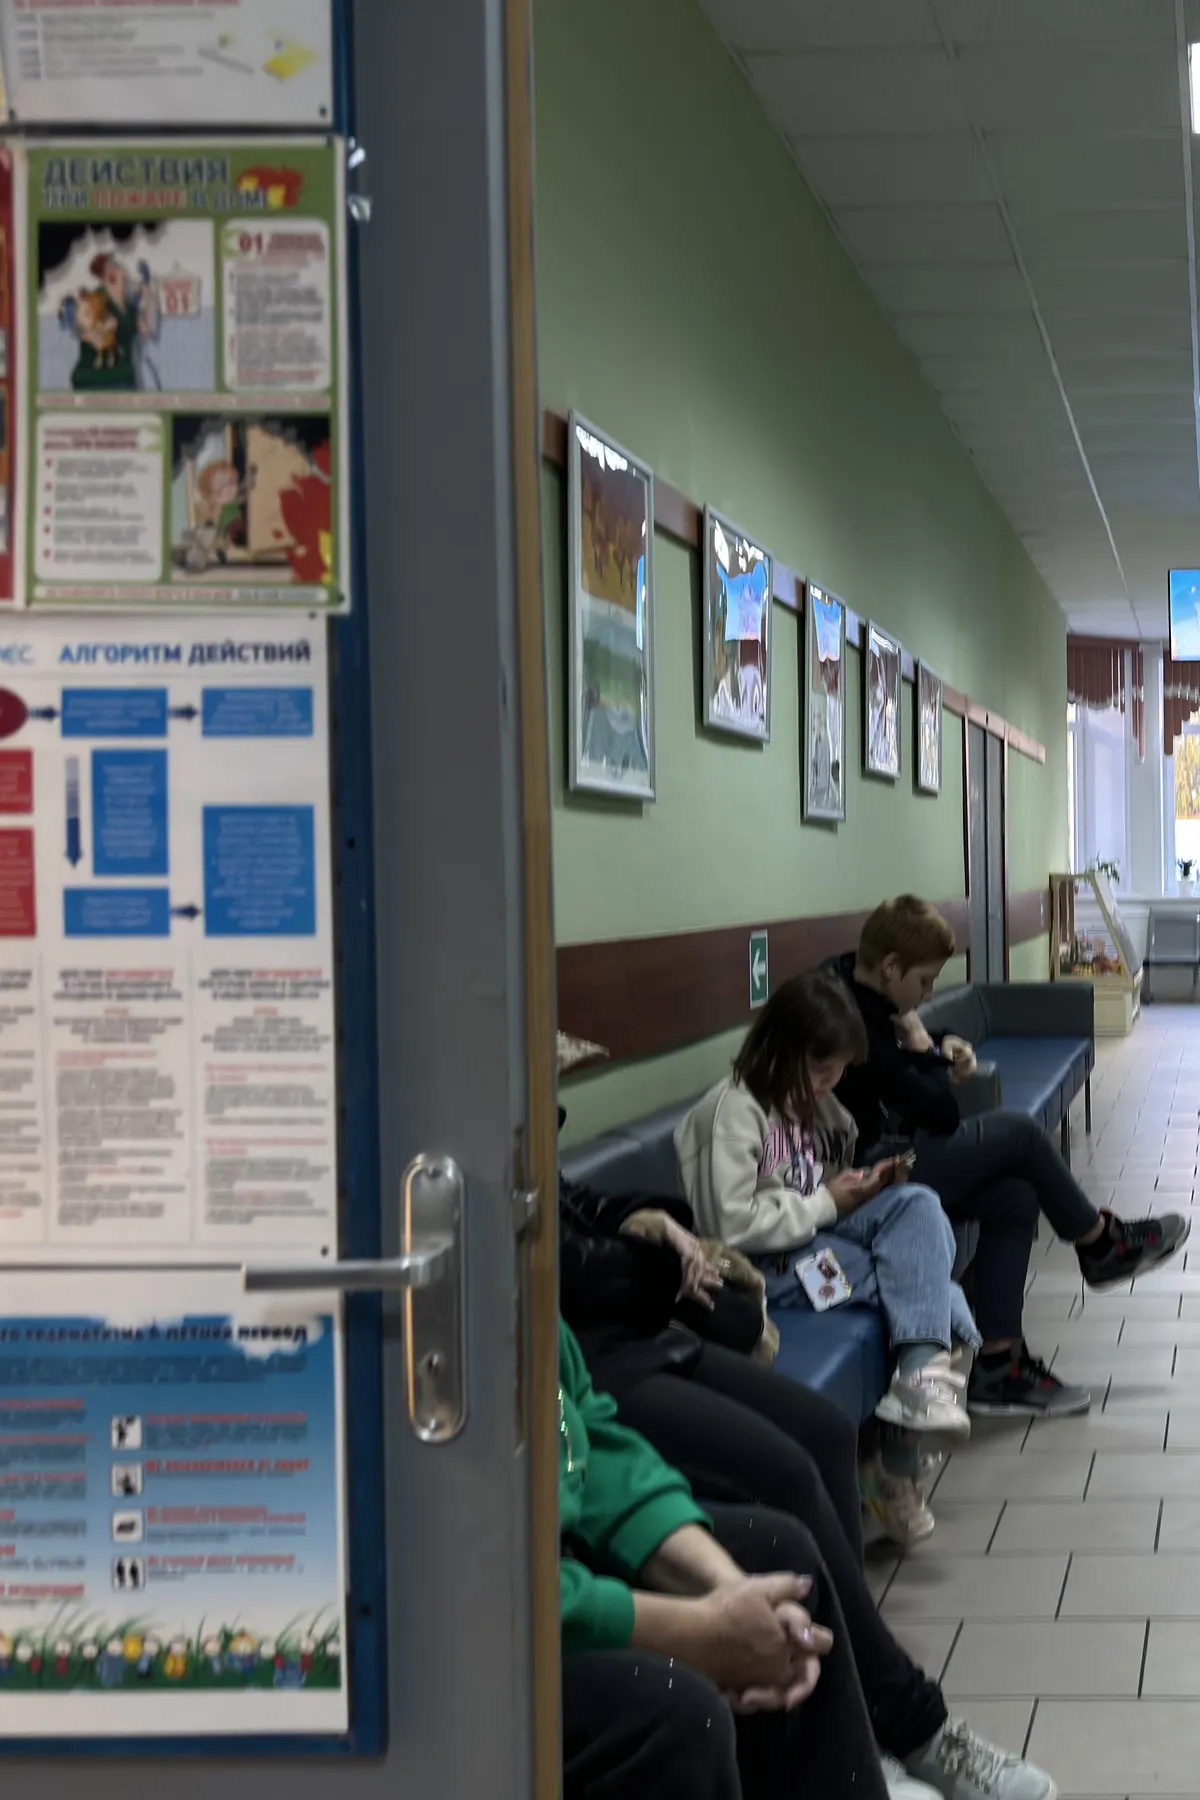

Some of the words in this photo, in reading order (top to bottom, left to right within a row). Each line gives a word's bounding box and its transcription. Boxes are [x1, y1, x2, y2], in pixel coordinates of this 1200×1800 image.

[44, 157, 229, 187] ДЕЙСТВИЯ
[58, 643, 182, 664] АЛГОРИТМ
[188, 640, 311, 666] ДЕЙСТВИЙ
